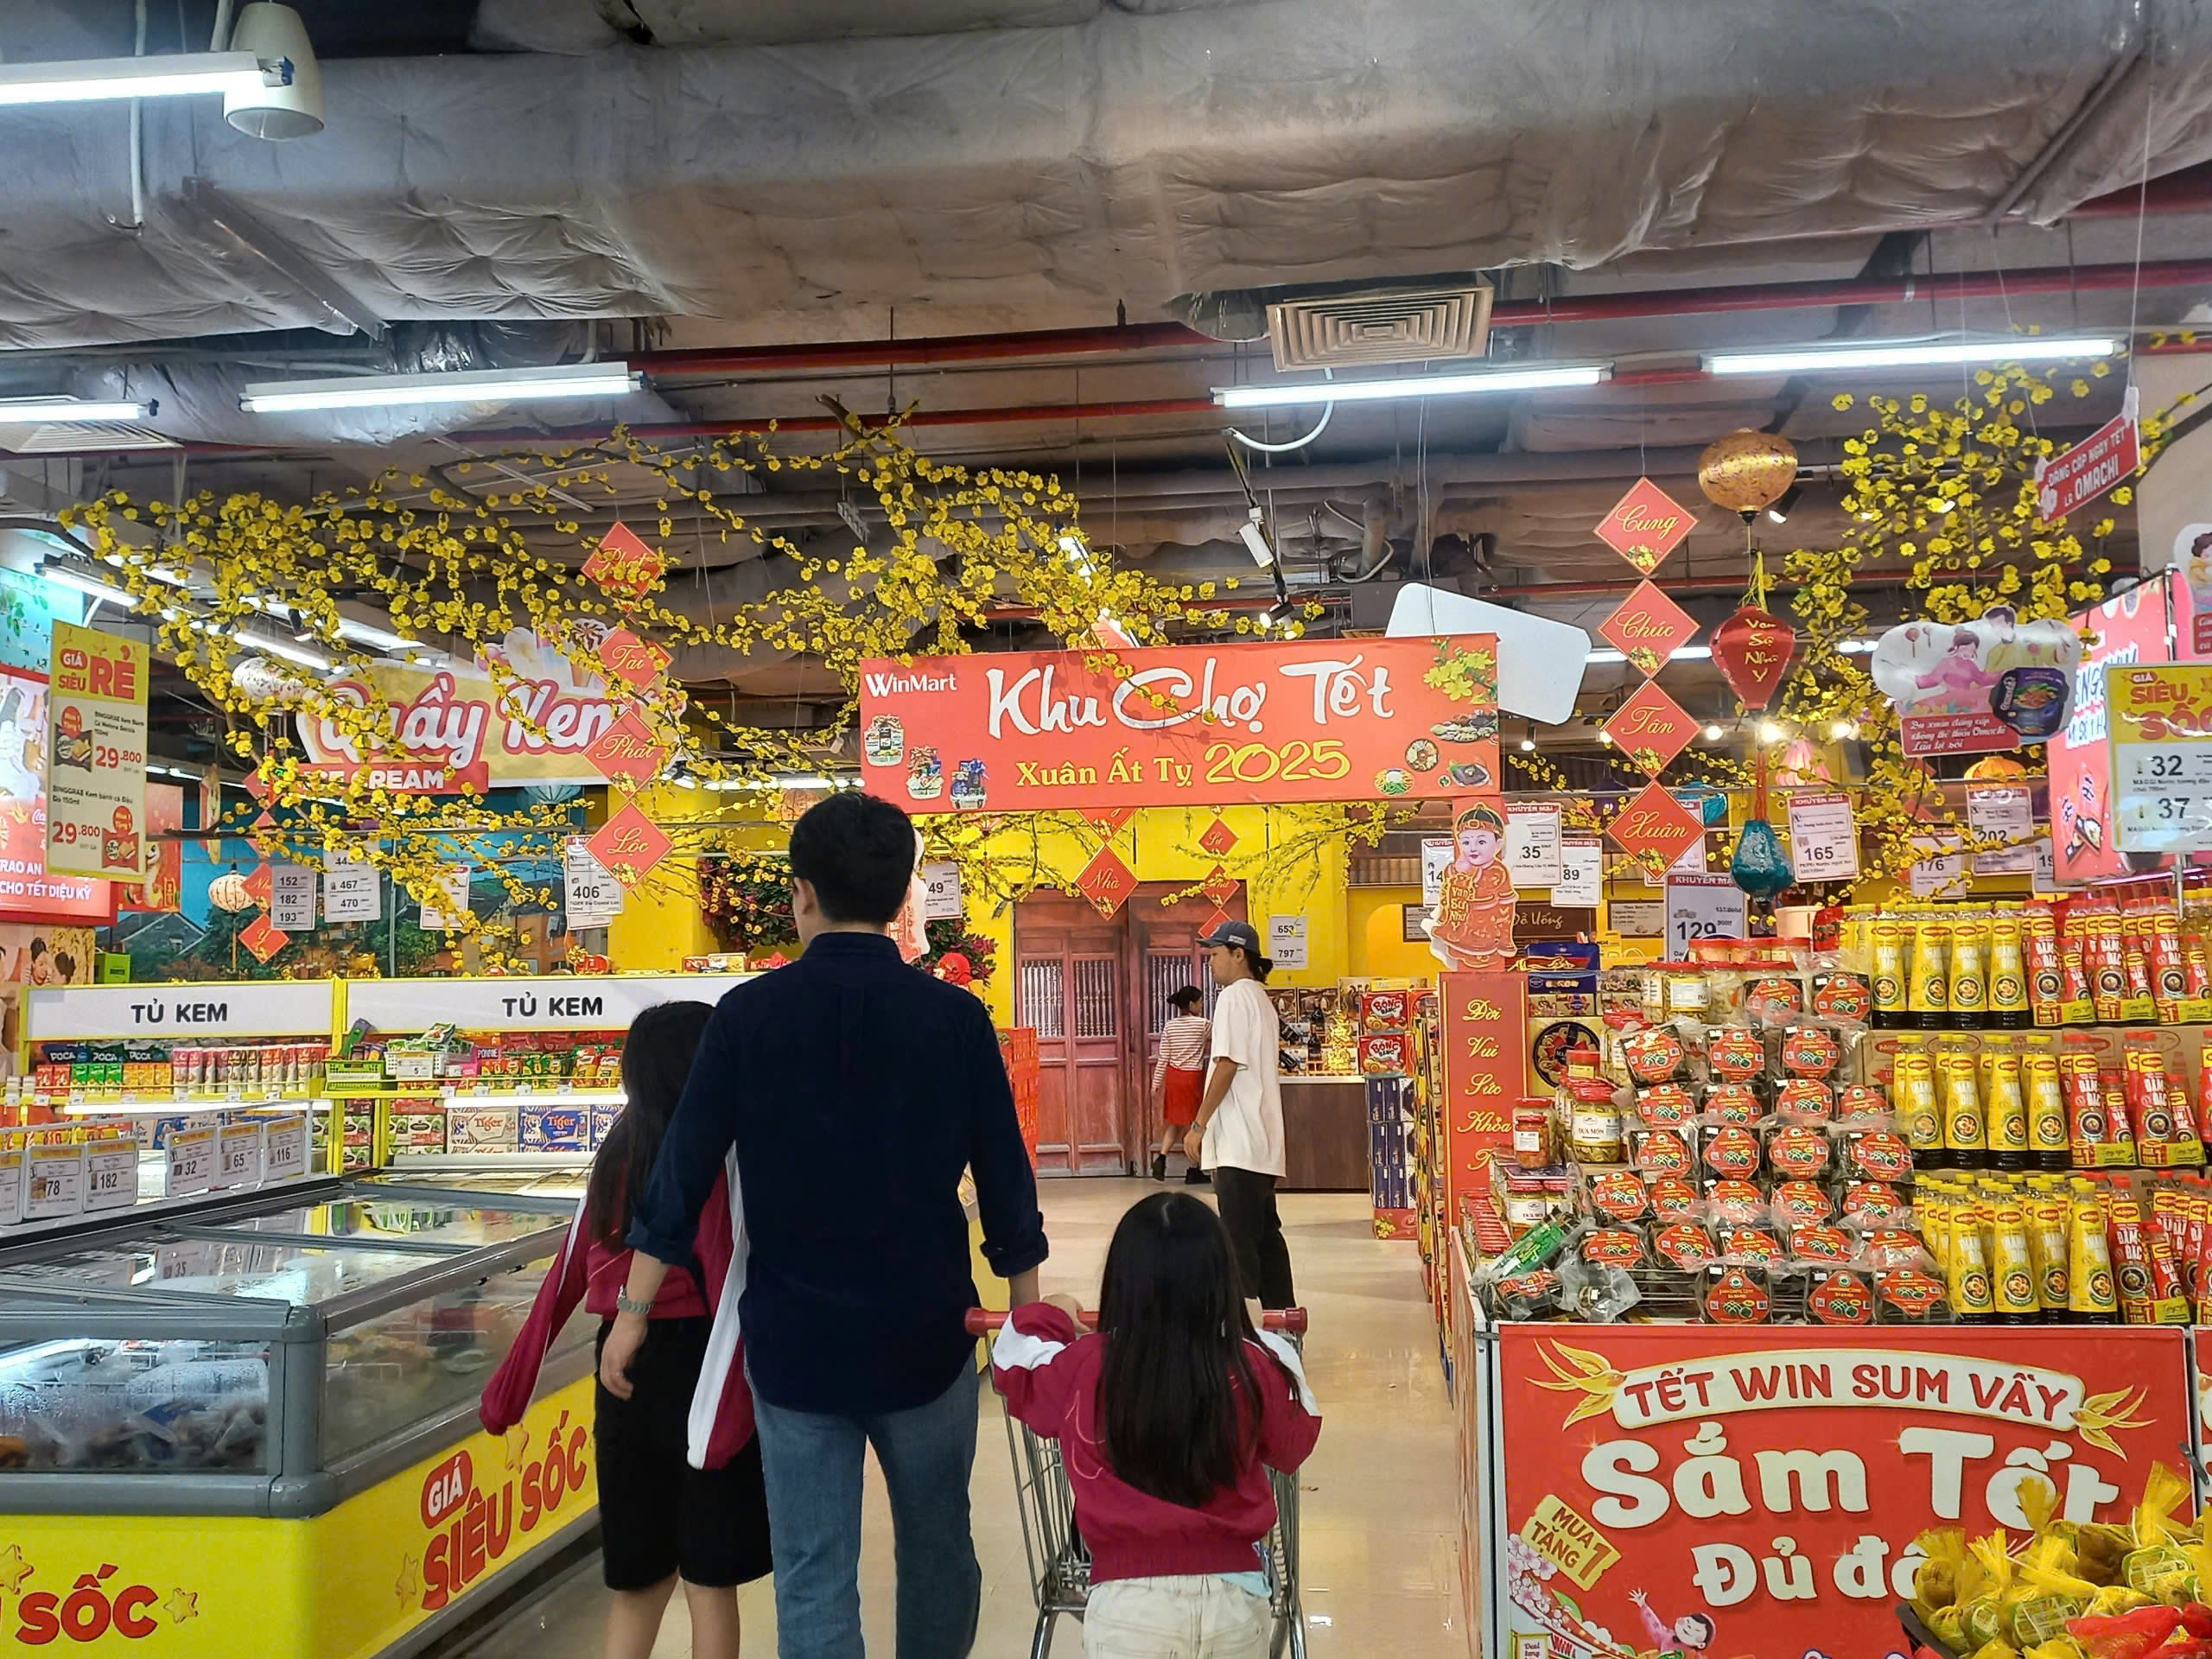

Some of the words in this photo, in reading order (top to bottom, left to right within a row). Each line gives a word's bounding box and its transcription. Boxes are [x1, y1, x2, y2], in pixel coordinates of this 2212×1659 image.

[2075, 454, 2120, 500] OMACHI
[1616, 504, 1679, 539] Cung
[1615, 611, 1675, 639] Chúc
[63, 652, 83, 667] GIÁ
[607, 645, 645, 671] Tài
[58, 672, 86, 691] SIÊU
[90, 645, 135, 700] RẺ
[2133, 672, 2153, 683] GIÁ
[864, 672, 957, 697] WinMart
[2131, 679, 2189, 705] SIÊU
[985, 664, 1107, 740] Khu
[1112, 657, 1267, 733] Chợ
[1279, 654, 1395, 726] Tết
[1620, 706, 1677, 734] Tân
[1016, 755, 1097, 787] Xuân
[1107, 746, 1143, 785] Ất
[1154, 757, 1193, 788] Tỵ
[1204, 740, 1351, 785] 2025
[2151, 754, 2183, 776] 32
[2158, 798, 2190, 819] 37
[1624, 810, 1688, 840] Xuân
[607, 826, 649, 857] Lộc
[1522, 845, 1541, 860] 35
[1804, 846, 1834, 861] 165
[27, 863, 42, 875] AN
[1082, 868, 1120, 890] Nhà
[1563, 868, 1580, 880] 89
[0, 881, 24, 893] CHO
[26, 879, 48, 896] TẾT
[48, 882, 75, 901] DIỆU
[279, 876, 298, 887] 152
[340, 880, 358, 890] 467
[572, 886, 601, 899] 406
[928, 881, 944, 894] 49
[1717, 876, 1733, 887] MẠ
[279, 894, 297, 905] 182
[340, 899, 359, 908] 470
[279, 912, 297, 922] 193
[1278, 949, 1294, 958] 797
[130, 997, 164, 1024] TỦ
[175, 1002, 229, 1023] KEM
[502, 991, 537, 1017] TỦ
[549, 996, 603, 1016] KEM
[1462, 999, 1503, 1021] Đời
[50, 1051, 77, 1061] POCA
[92, 1051, 118, 1062] POCA
[1467, 1036, 1500, 1058] Vui
[1465, 1073, 1503, 1096] Sức
[475, 1116, 503, 1132] Tiger
[547, 1116, 575, 1130] Tiger
[232, 1153, 245, 1167] 65
[276, 1147, 291, 1162] 116
[184, 1160, 197, 1176] 32
[47, 1180, 60, 1197] 78
[100, 1173, 118, 1190] 182
[1625, 1367, 1714, 1418] TẾT
[1729, 1363, 1831, 1402] WIN
[1852, 1363, 1949, 1405] SUM
[1968, 1372, 2069, 1421] VẦY
[427, 1455, 464, 1519] GIÁ
[1581, 1421, 1869, 1529] Sắm
[1899, 1427, 2120, 1531] Tết
[421, 1479, 513, 1611] SIÊU
[519, 1409, 588, 1533] SỐC
[1551, 1506, 1595, 1549] MUA
[1530, 1521, 1580, 1569] TẶNG
[1578, 1542, 1612, 1581] 1
[1691, 1535, 1818, 1608] Đủ
[15, 1562, 159, 1645] SỐC
